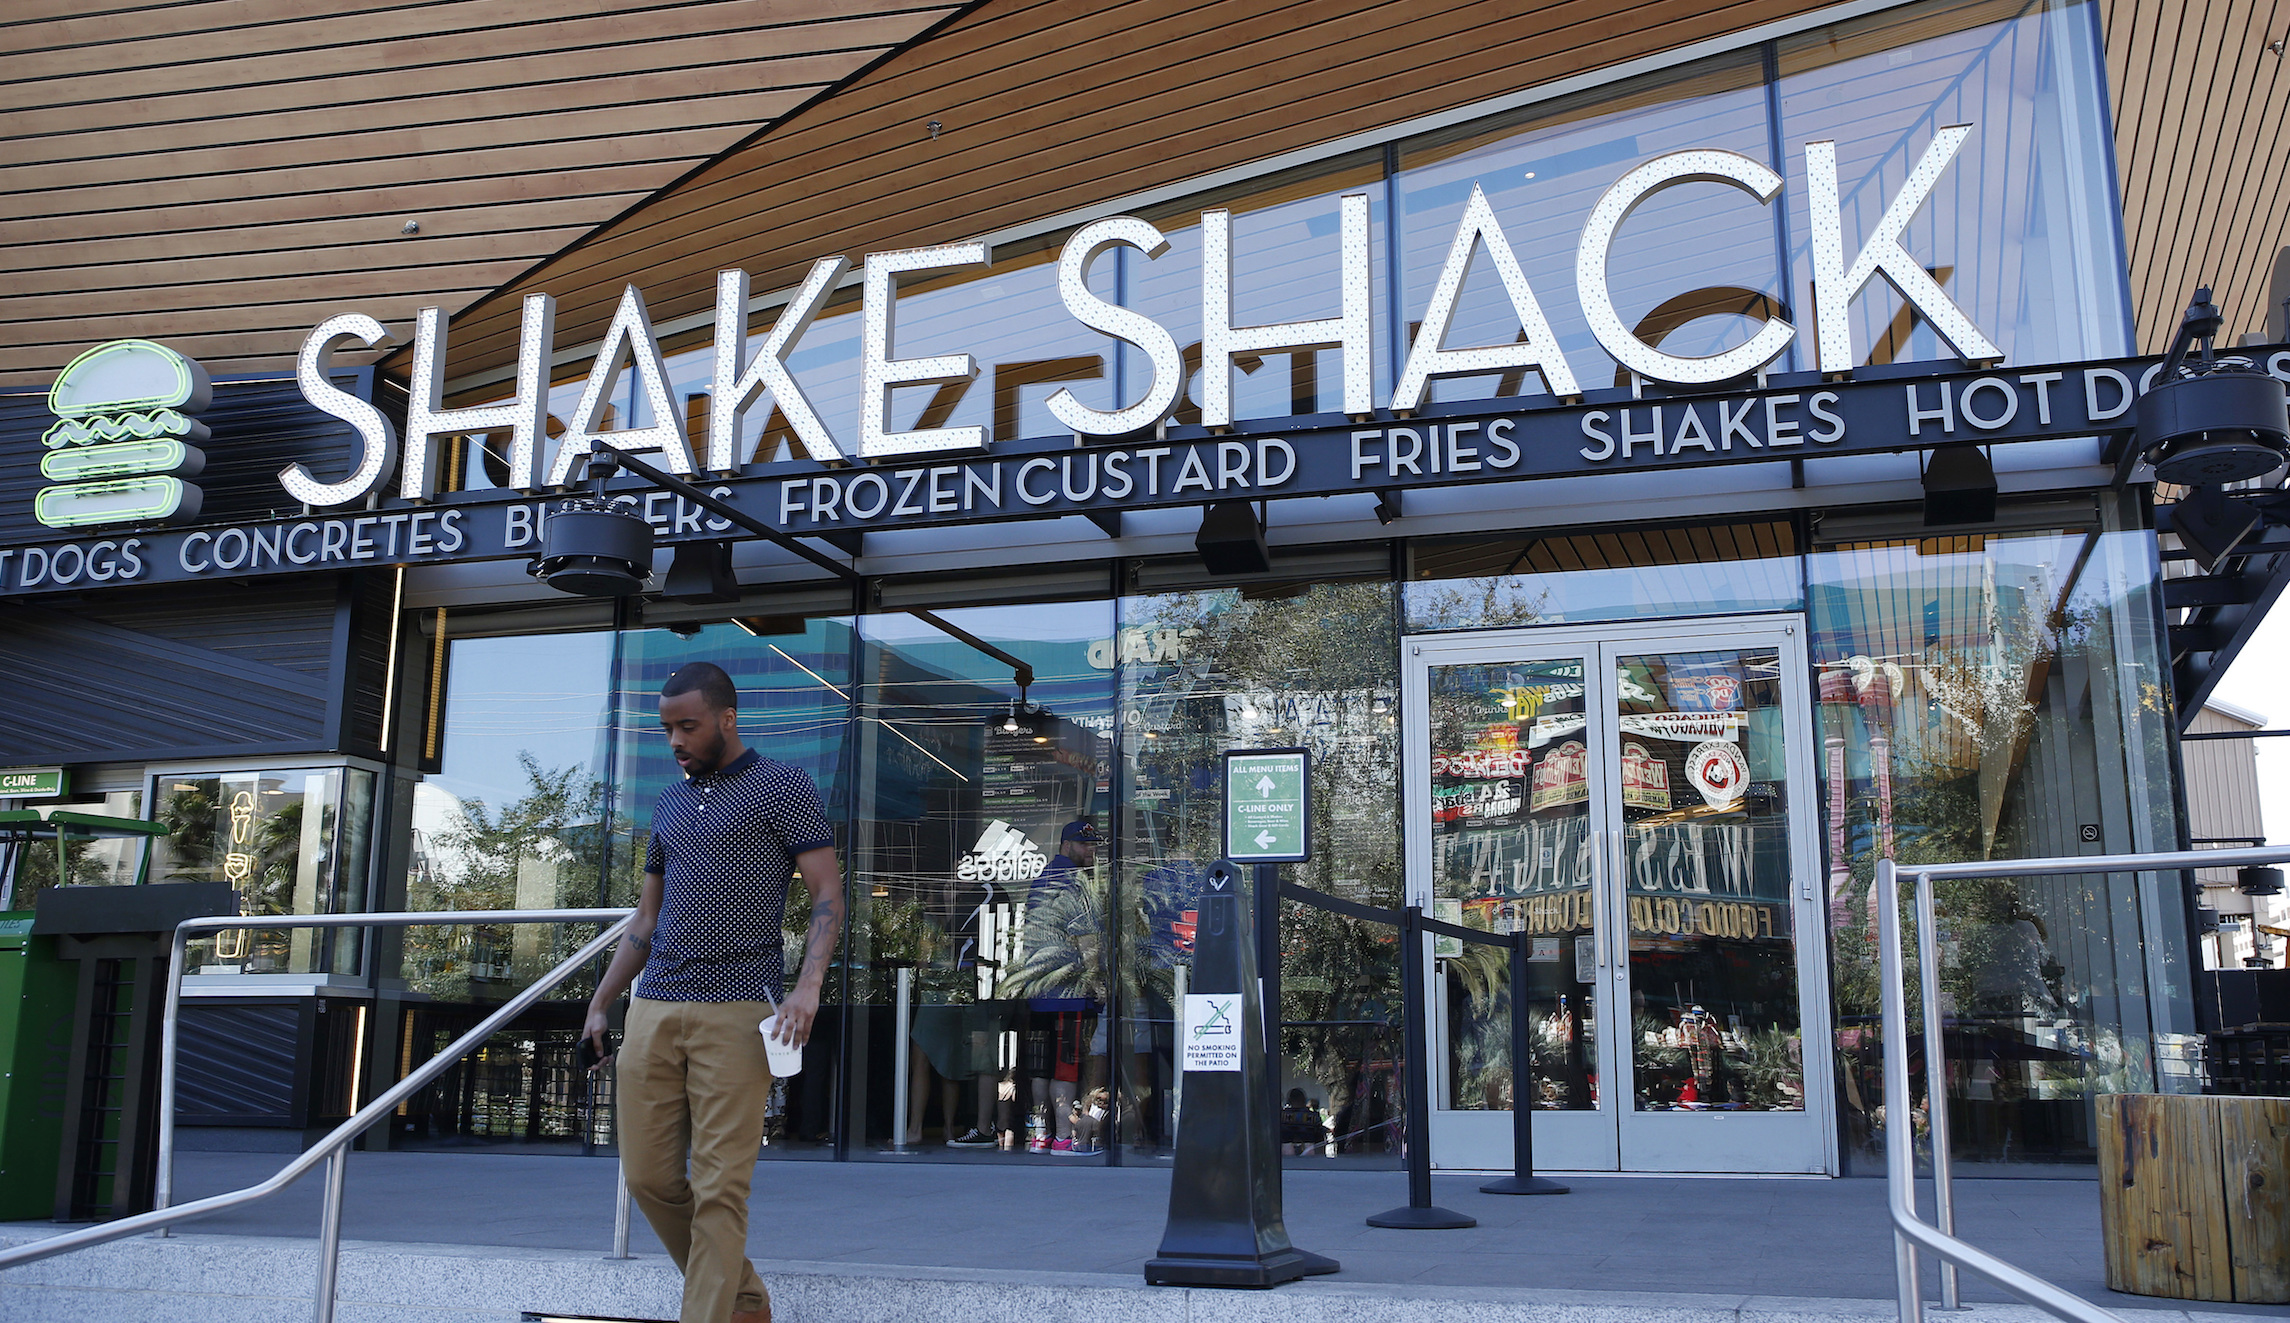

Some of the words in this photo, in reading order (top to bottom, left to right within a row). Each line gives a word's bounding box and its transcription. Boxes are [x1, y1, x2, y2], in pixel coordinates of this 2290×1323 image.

[277, 241, 992, 507] SHAKE
[1045, 123, 2004, 435] SHACK
[1579, 390, 1846, 461] SHAKES
[1906, 371, 2063, 436] HOT
[779, 460, 1001, 526] FROZEN
[1016, 437, 1298, 506] CUSTARD
[1350, 418, 1522, 481] FRIES
[20, 538, 142, 587] DOGS
[179, 508, 464, 574] CONCRETES
[2, 775, 37, 787] C-LINE
[1233, 766, 1247, 774] ALL
[1249, 765, 1273, 773] MENU
[1238, 804, 1266, 813] C-LINE
[1268, 804, 1294, 812] ONLY
